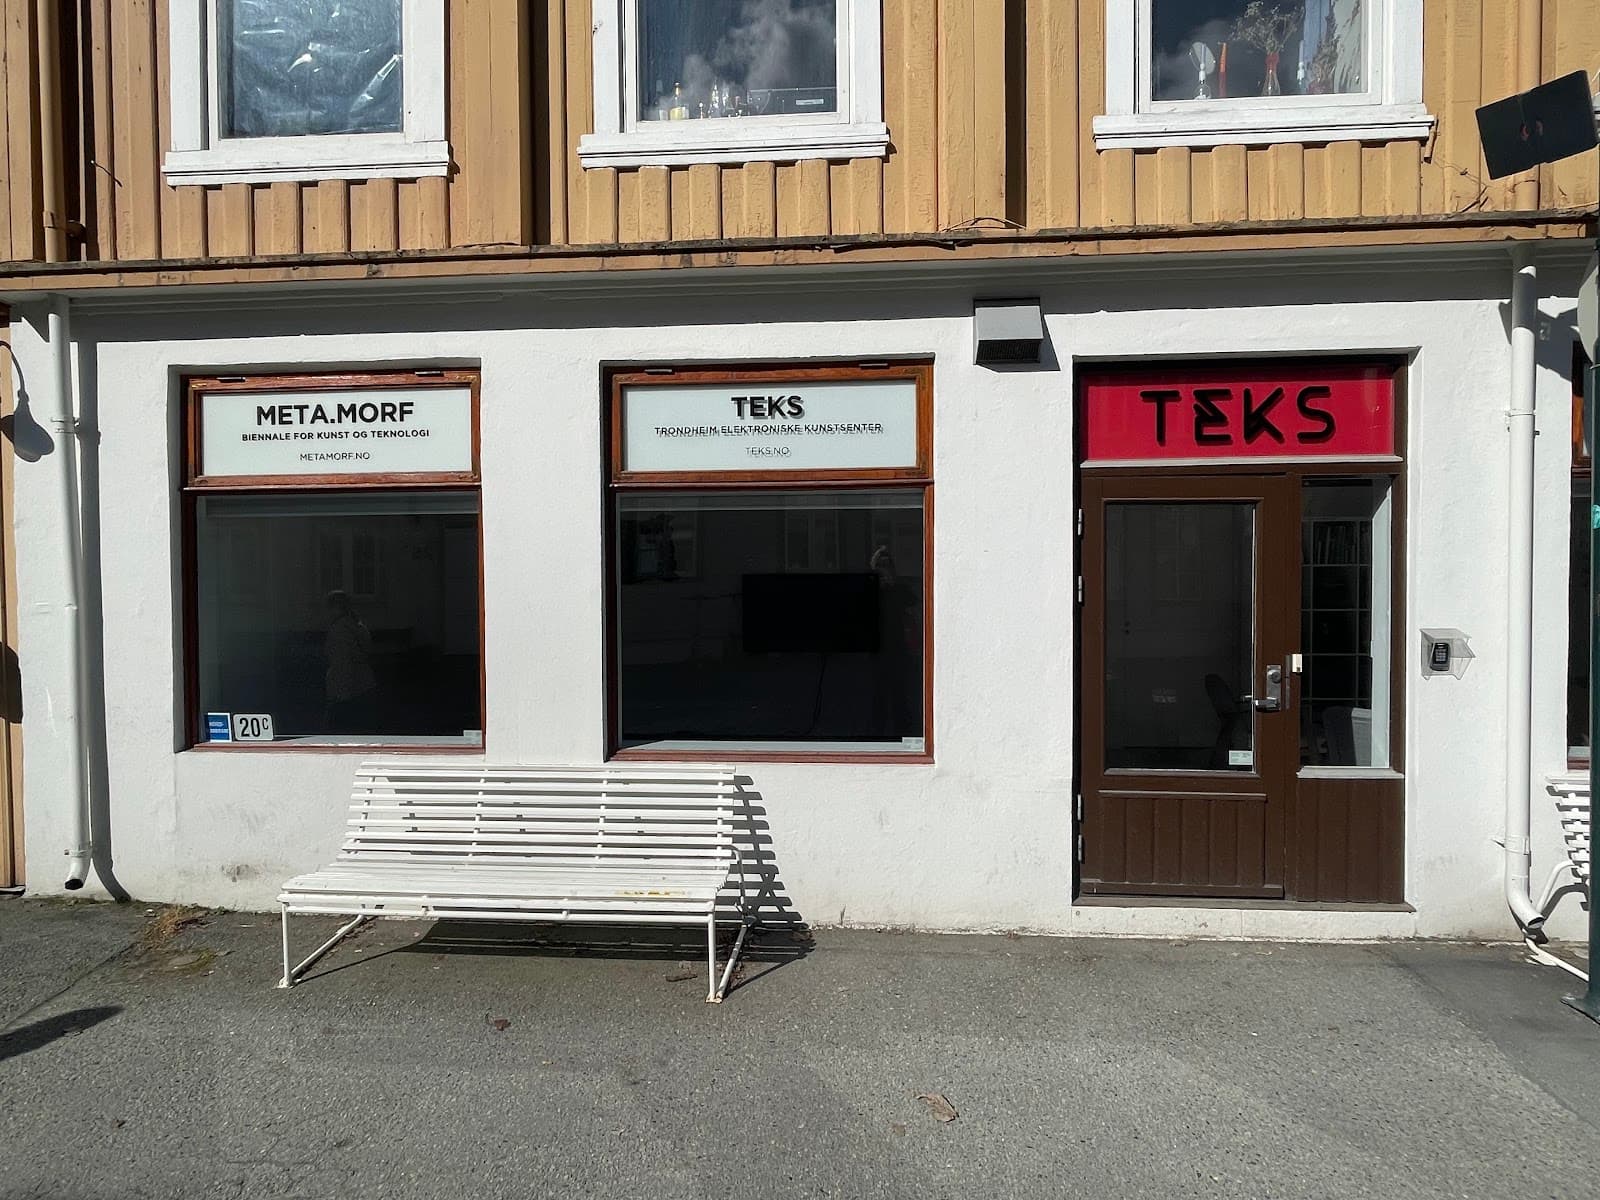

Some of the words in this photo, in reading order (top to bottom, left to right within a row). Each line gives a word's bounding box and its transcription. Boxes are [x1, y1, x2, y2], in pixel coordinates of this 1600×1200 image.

[256, 401, 414, 426] META.MORF
[731, 395, 804, 419] TEKS
[1139, 385, 1337, 443] TEKS
[241, 432, 291, 441] BIENNALE
[293, 432, 314, 440] FOR
[317, 431, 350, 440] KUNST
[352, 430, 368, 439] OG
[370, 429, 430, 438] TEKNOLOGI
[654, 425, 719, 436] TRONDHEIM
[721, 424, 801, 435] ELEKTRONISKE
[804, 423, 883, 433] KUNSTSENTER
